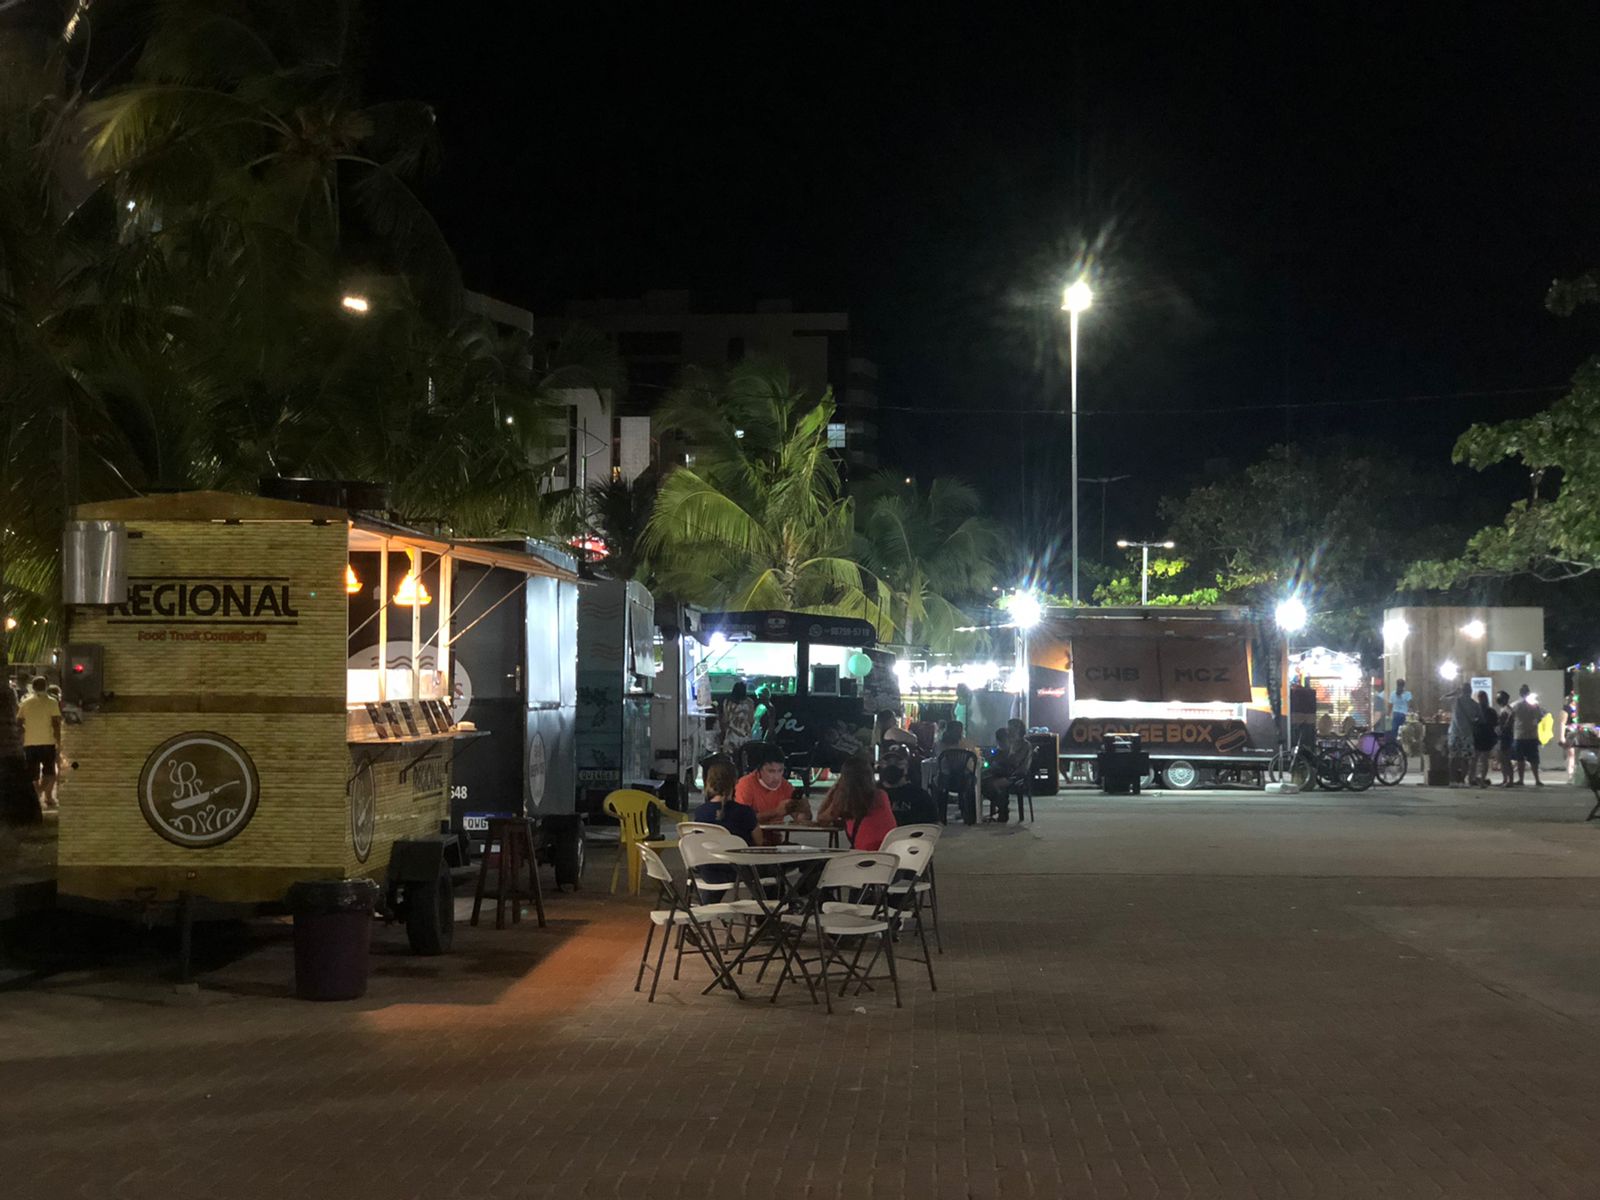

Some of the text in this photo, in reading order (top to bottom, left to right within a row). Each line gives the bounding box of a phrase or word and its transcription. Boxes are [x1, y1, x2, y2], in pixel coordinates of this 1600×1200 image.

[138, 630, 166, 641] Food
[1085, 667, 1140, 682] CWB
[1174, 667, 1230, 683] MCZ
